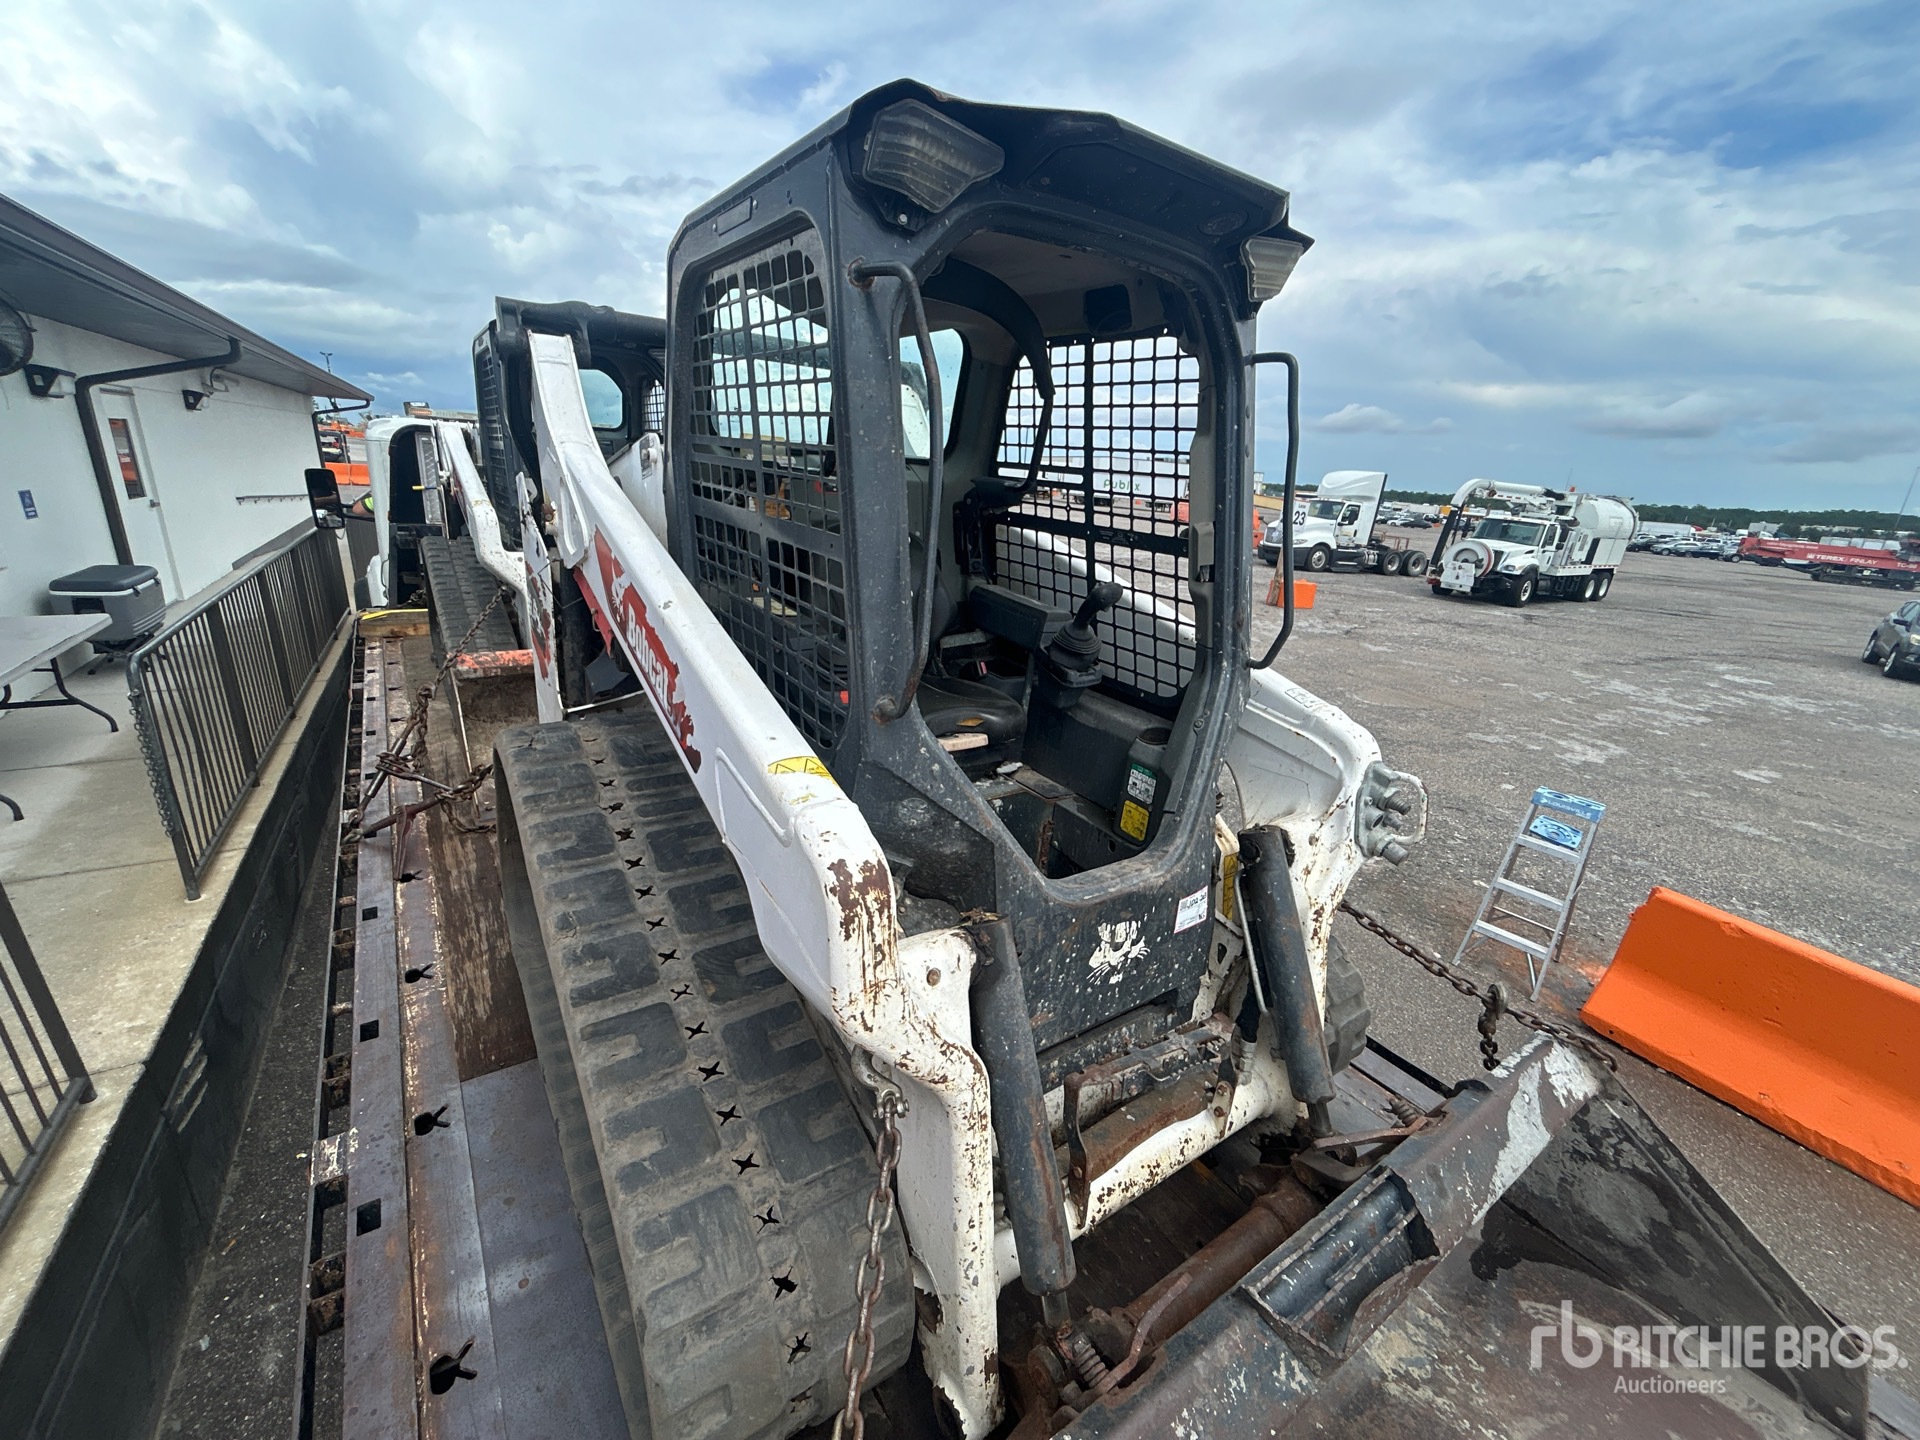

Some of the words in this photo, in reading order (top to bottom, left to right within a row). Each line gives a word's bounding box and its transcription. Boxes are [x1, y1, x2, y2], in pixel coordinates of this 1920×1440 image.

[1103, 479, 1140, 491] Publx
[1293, 510, 1306, 526] 23
[1816, 554, 1845, 562] TEREX
[1849, 557, 1878, 565] FINLAY
[626, 602, 669, 713] Bobcat
[1548, 800, 1592, 817] LOUISVILLE
